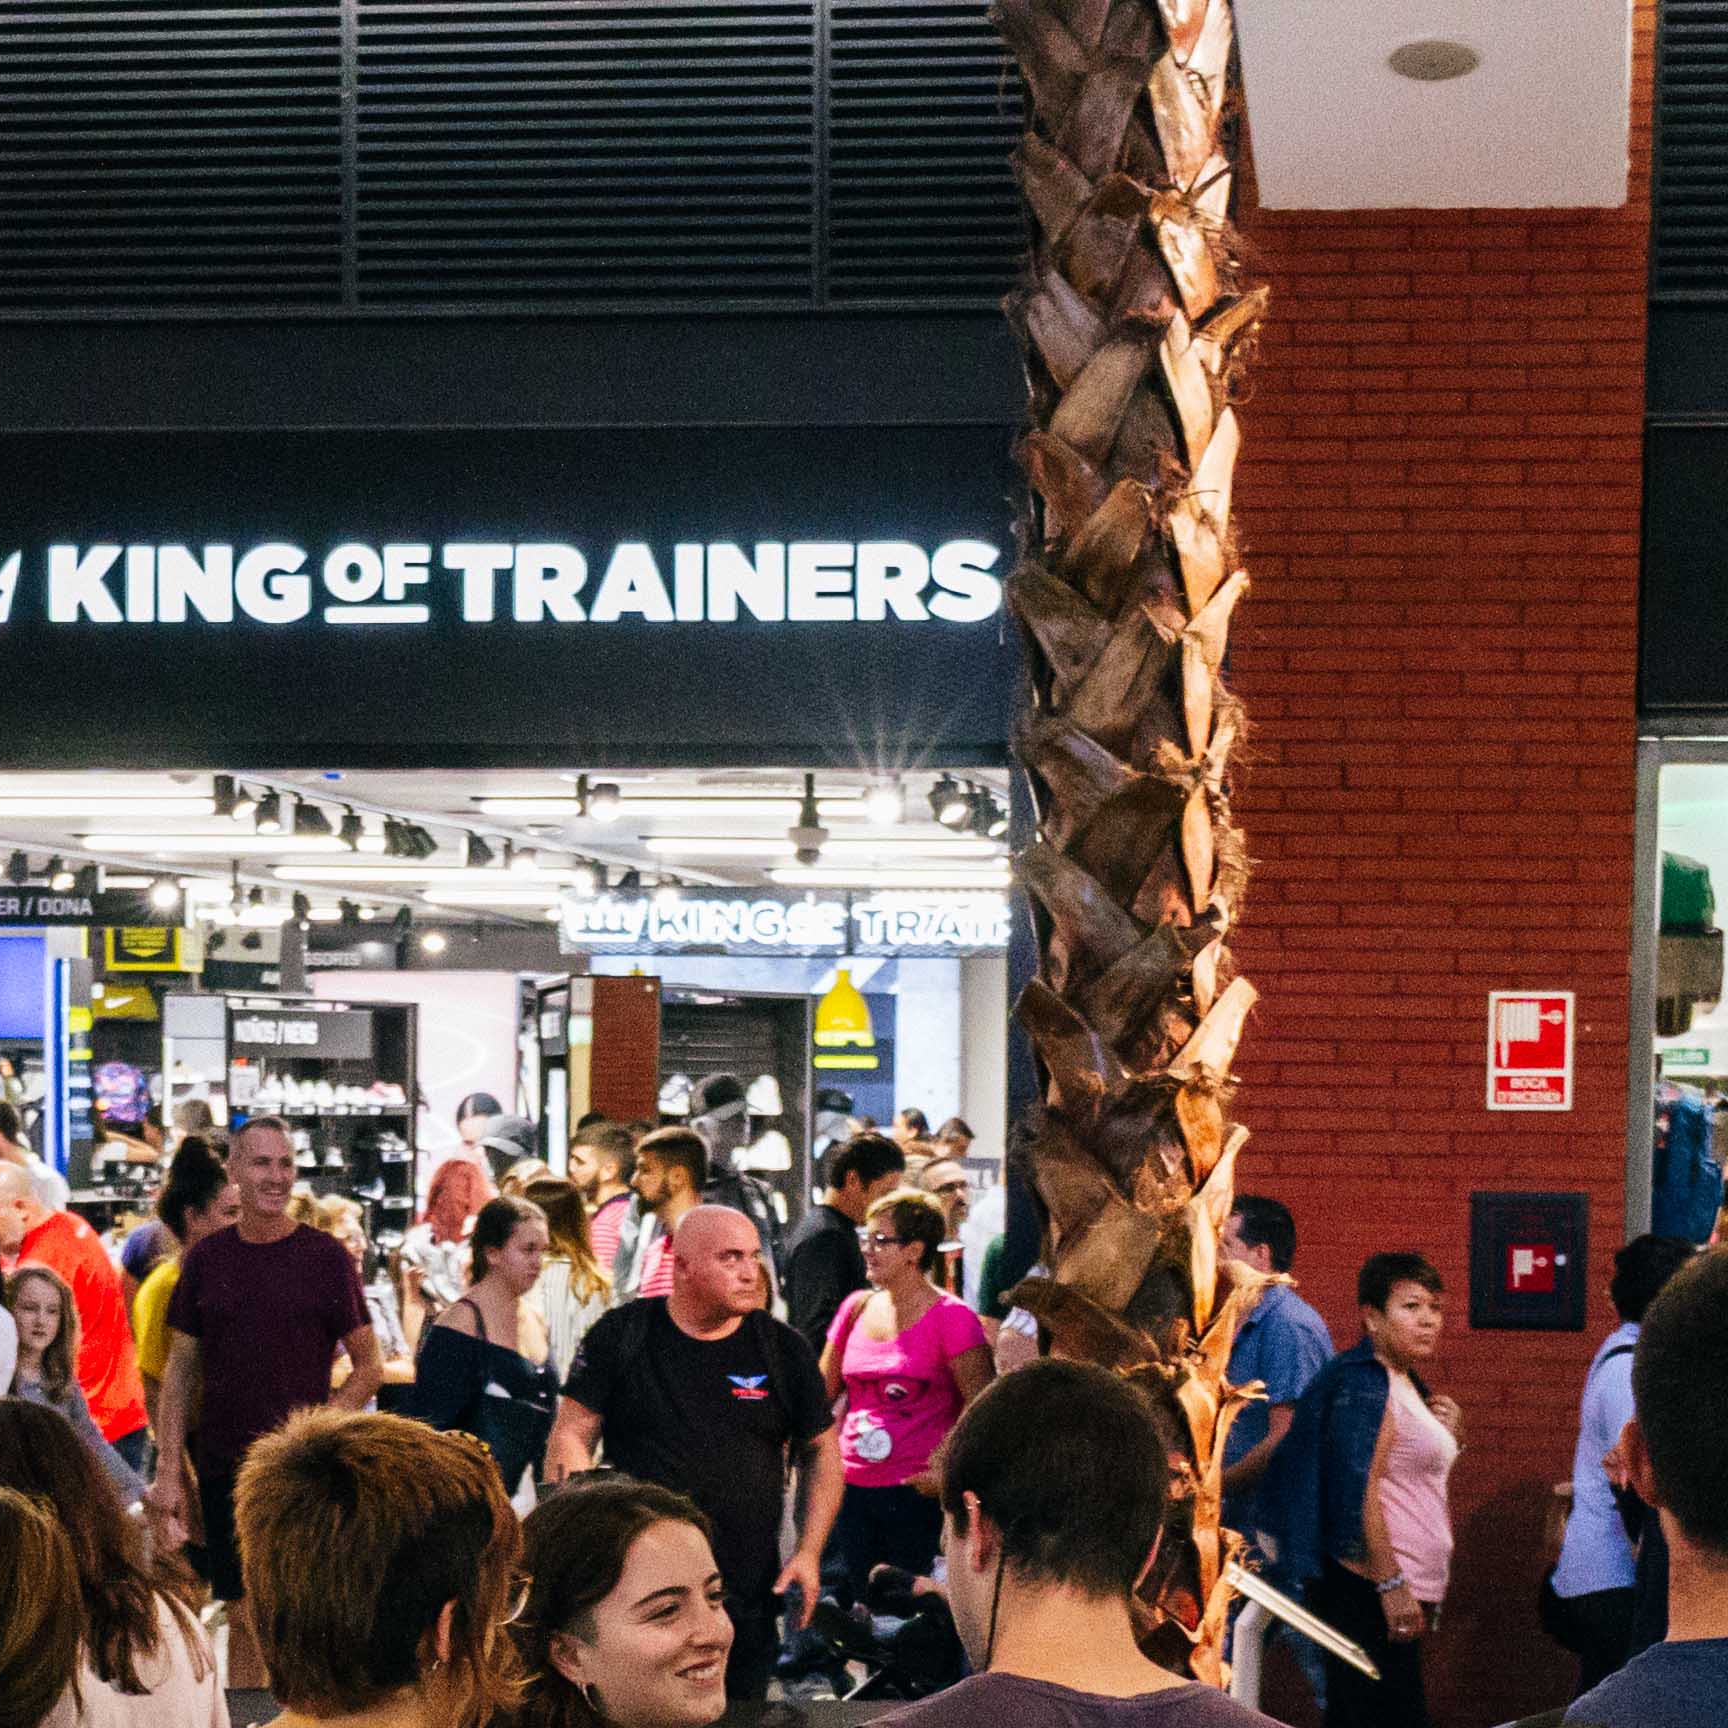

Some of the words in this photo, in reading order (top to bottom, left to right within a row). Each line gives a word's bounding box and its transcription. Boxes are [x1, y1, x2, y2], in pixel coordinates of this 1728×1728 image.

[47, 542, 313, 625] KING
[323, 542, 431, 604] OF
[442, 539, 1004, 624] TRAINERS
